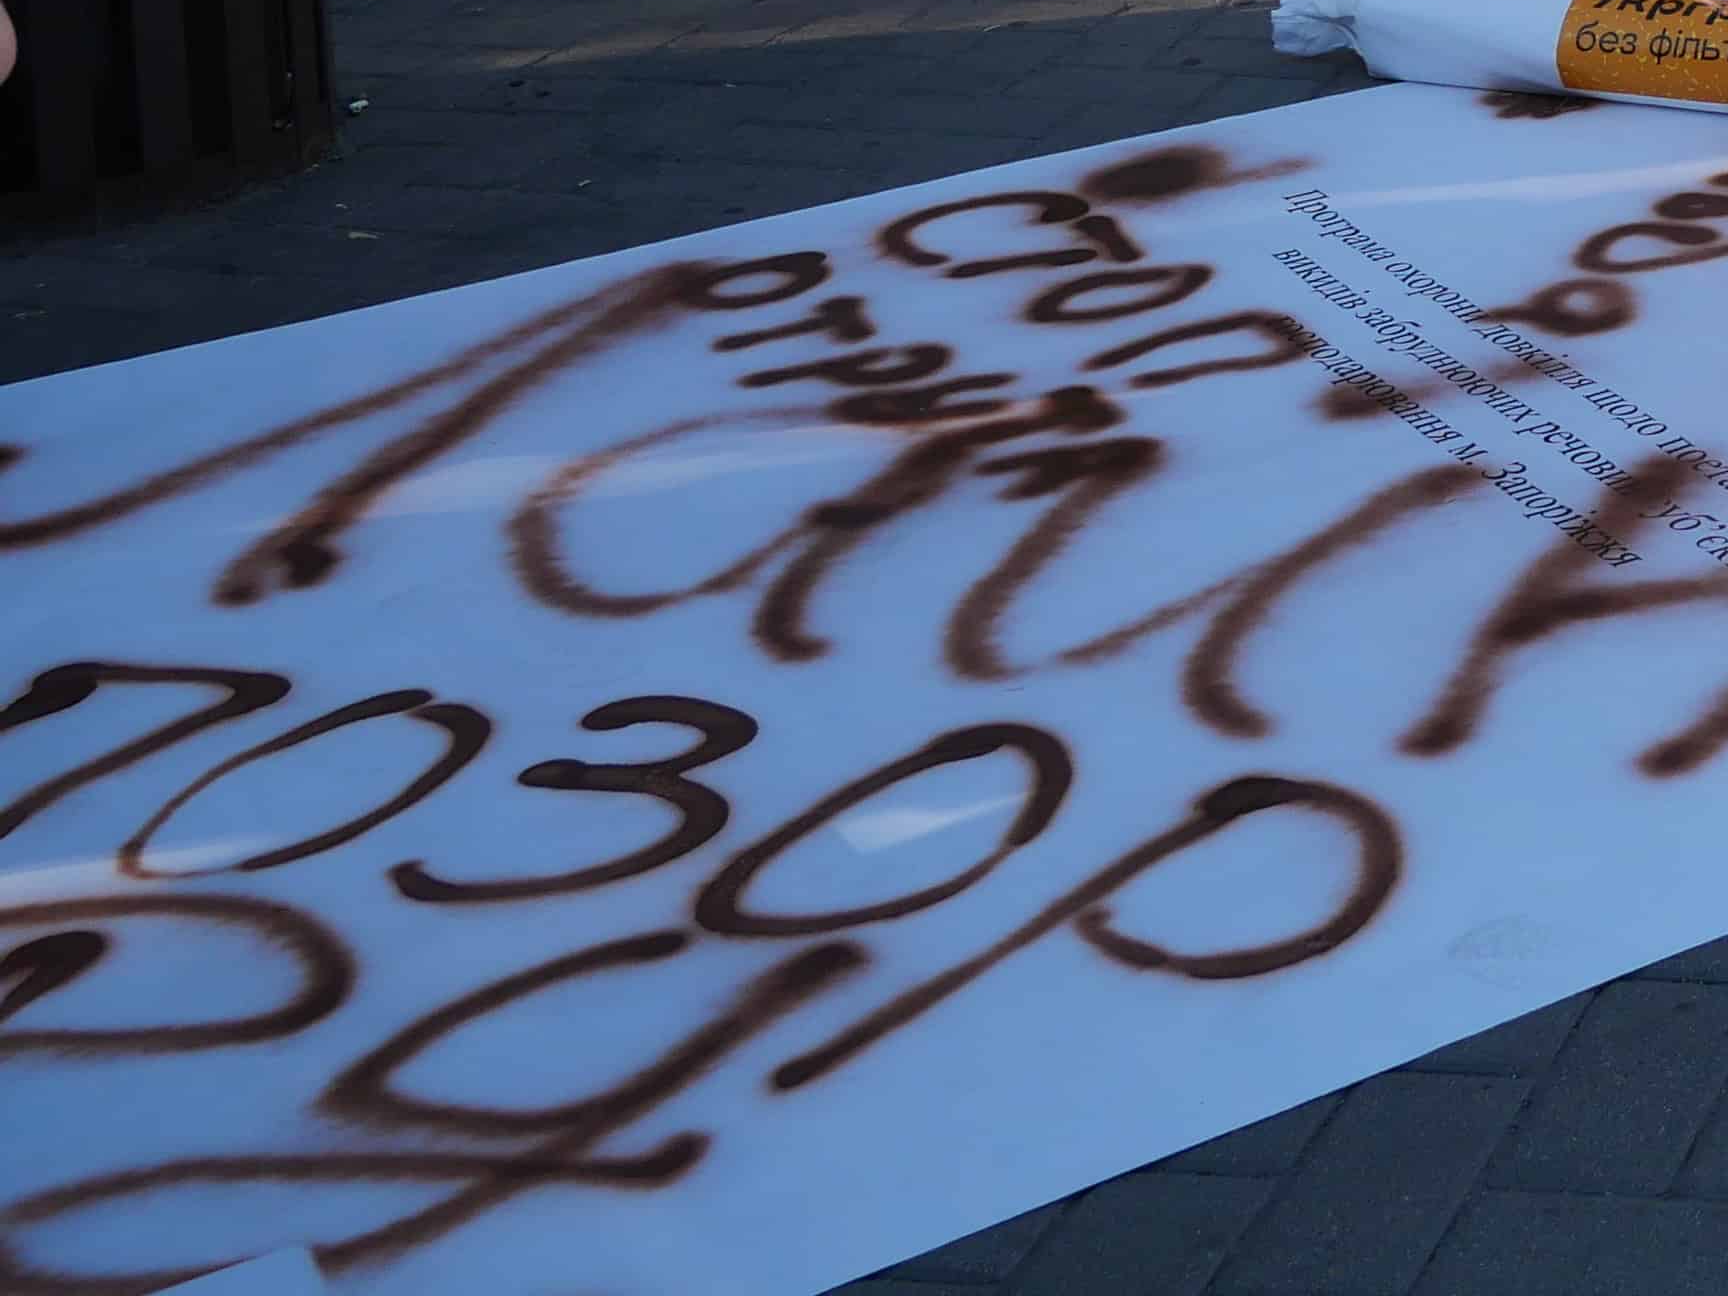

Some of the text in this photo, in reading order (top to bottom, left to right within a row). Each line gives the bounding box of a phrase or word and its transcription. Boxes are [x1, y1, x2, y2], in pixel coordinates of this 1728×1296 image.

[1575, 21, 1638, 56] без
[873, 190, 1308, 391] СТОП
[1272, 249, 1370, 310] викидів
[1355, 308, 1541, 423] забруднюючих
[1282, 189, 1395, 263] Програма
[1385, 261, 1493, 325] охорони
[1472, 324, 1599, 391] довкілля
[1583, 388, 1667, 438] щодо
[1451, 442, 1489, 466] м.
[1481, 461, 1644, 568] Запоріжжя
